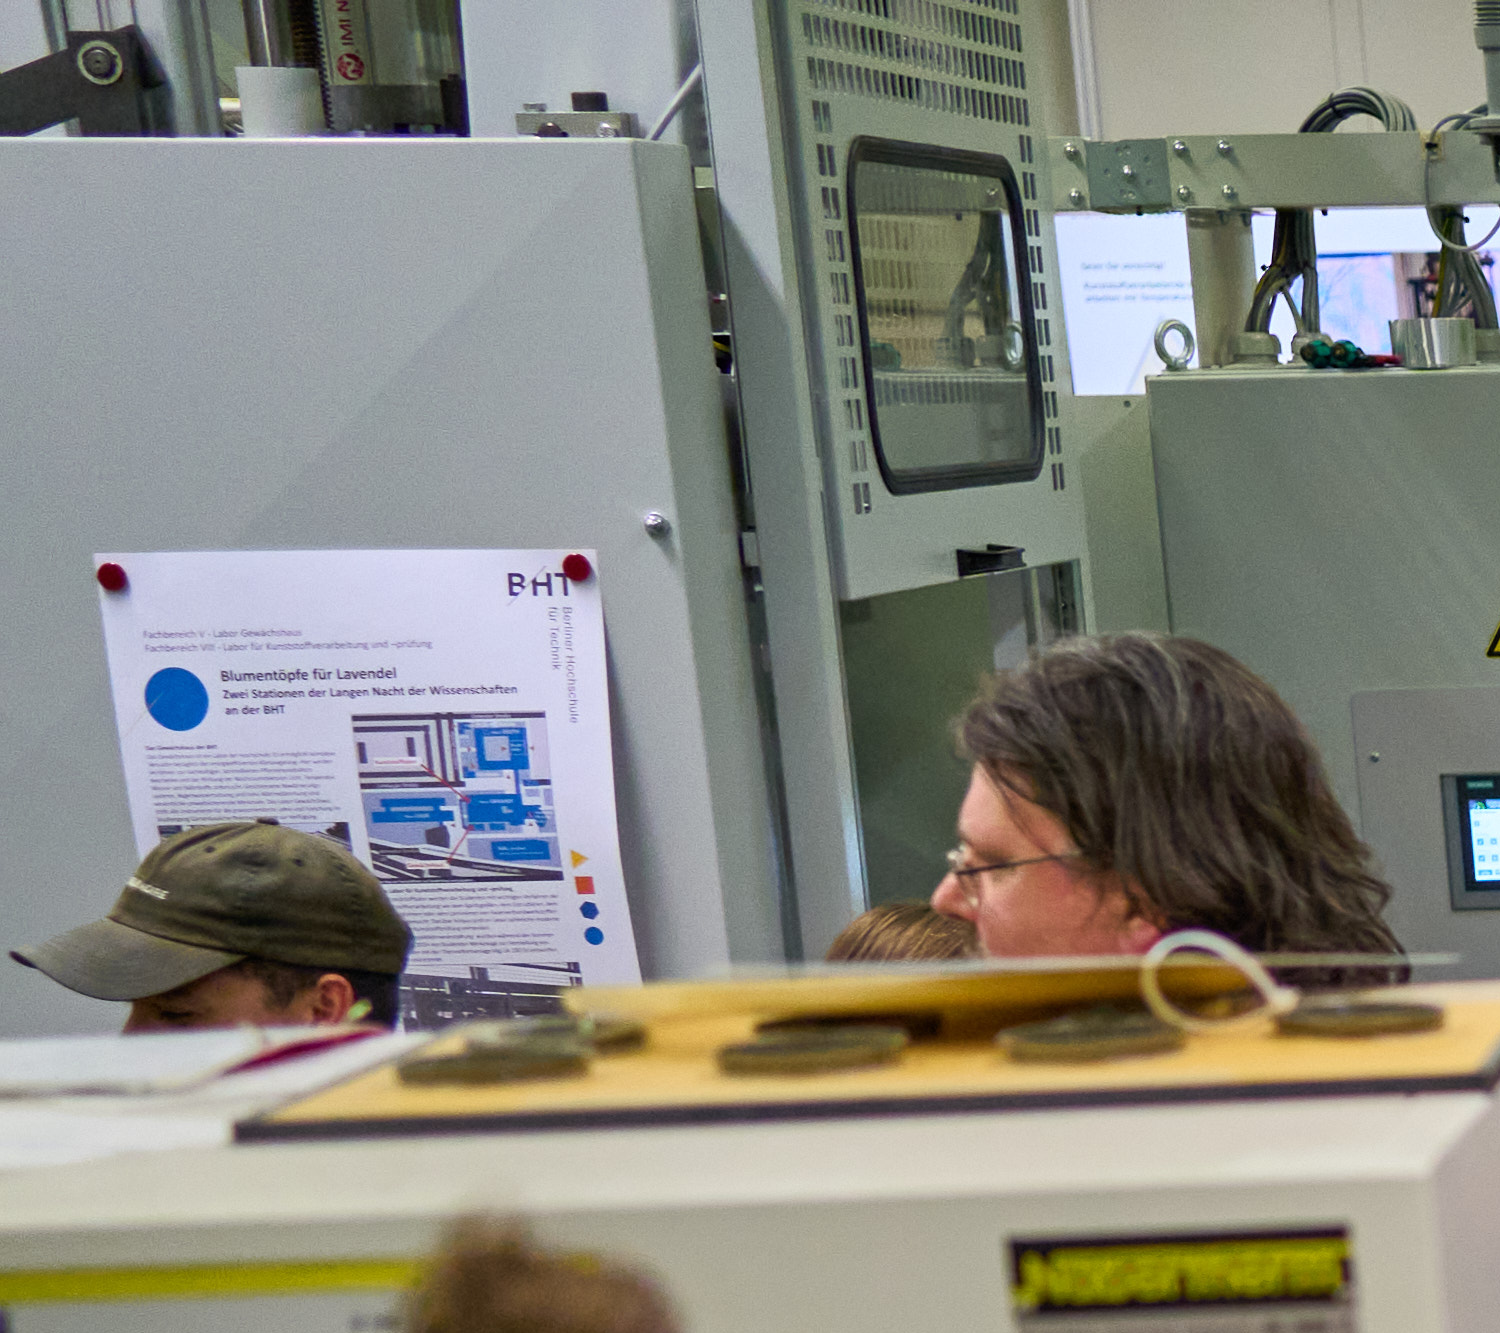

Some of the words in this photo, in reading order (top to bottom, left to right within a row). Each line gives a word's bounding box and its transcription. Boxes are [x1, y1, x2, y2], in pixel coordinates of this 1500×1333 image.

[338, 19, 355, 46] IMI
[507, 572, 569, 597] BHT
[562, 607, 575, 652] Berliner
[550, 627, 563, 670] Technik
[220, 668, 309, 683] Blumentöpfe
[313, 668, 332, 680] für
[336, 667, 398, 680] Lavendel
[223, 689, 249, 699] Zwei
[252, 688, 305, 699] Stationen
[308, 688, 326, 698] der
[330, 688, 369, 700] Langen
[373, 687, 404, 697] Nacht
[408, 686, 426, 697] der
[430, 685, 518, 696] Wissenschaften
[565, 655, 579, 724] Hochschule
[225, 706, 239, 715] an
[241, 705, 260, 715] der
[263, 705, 286, 714] BHT
